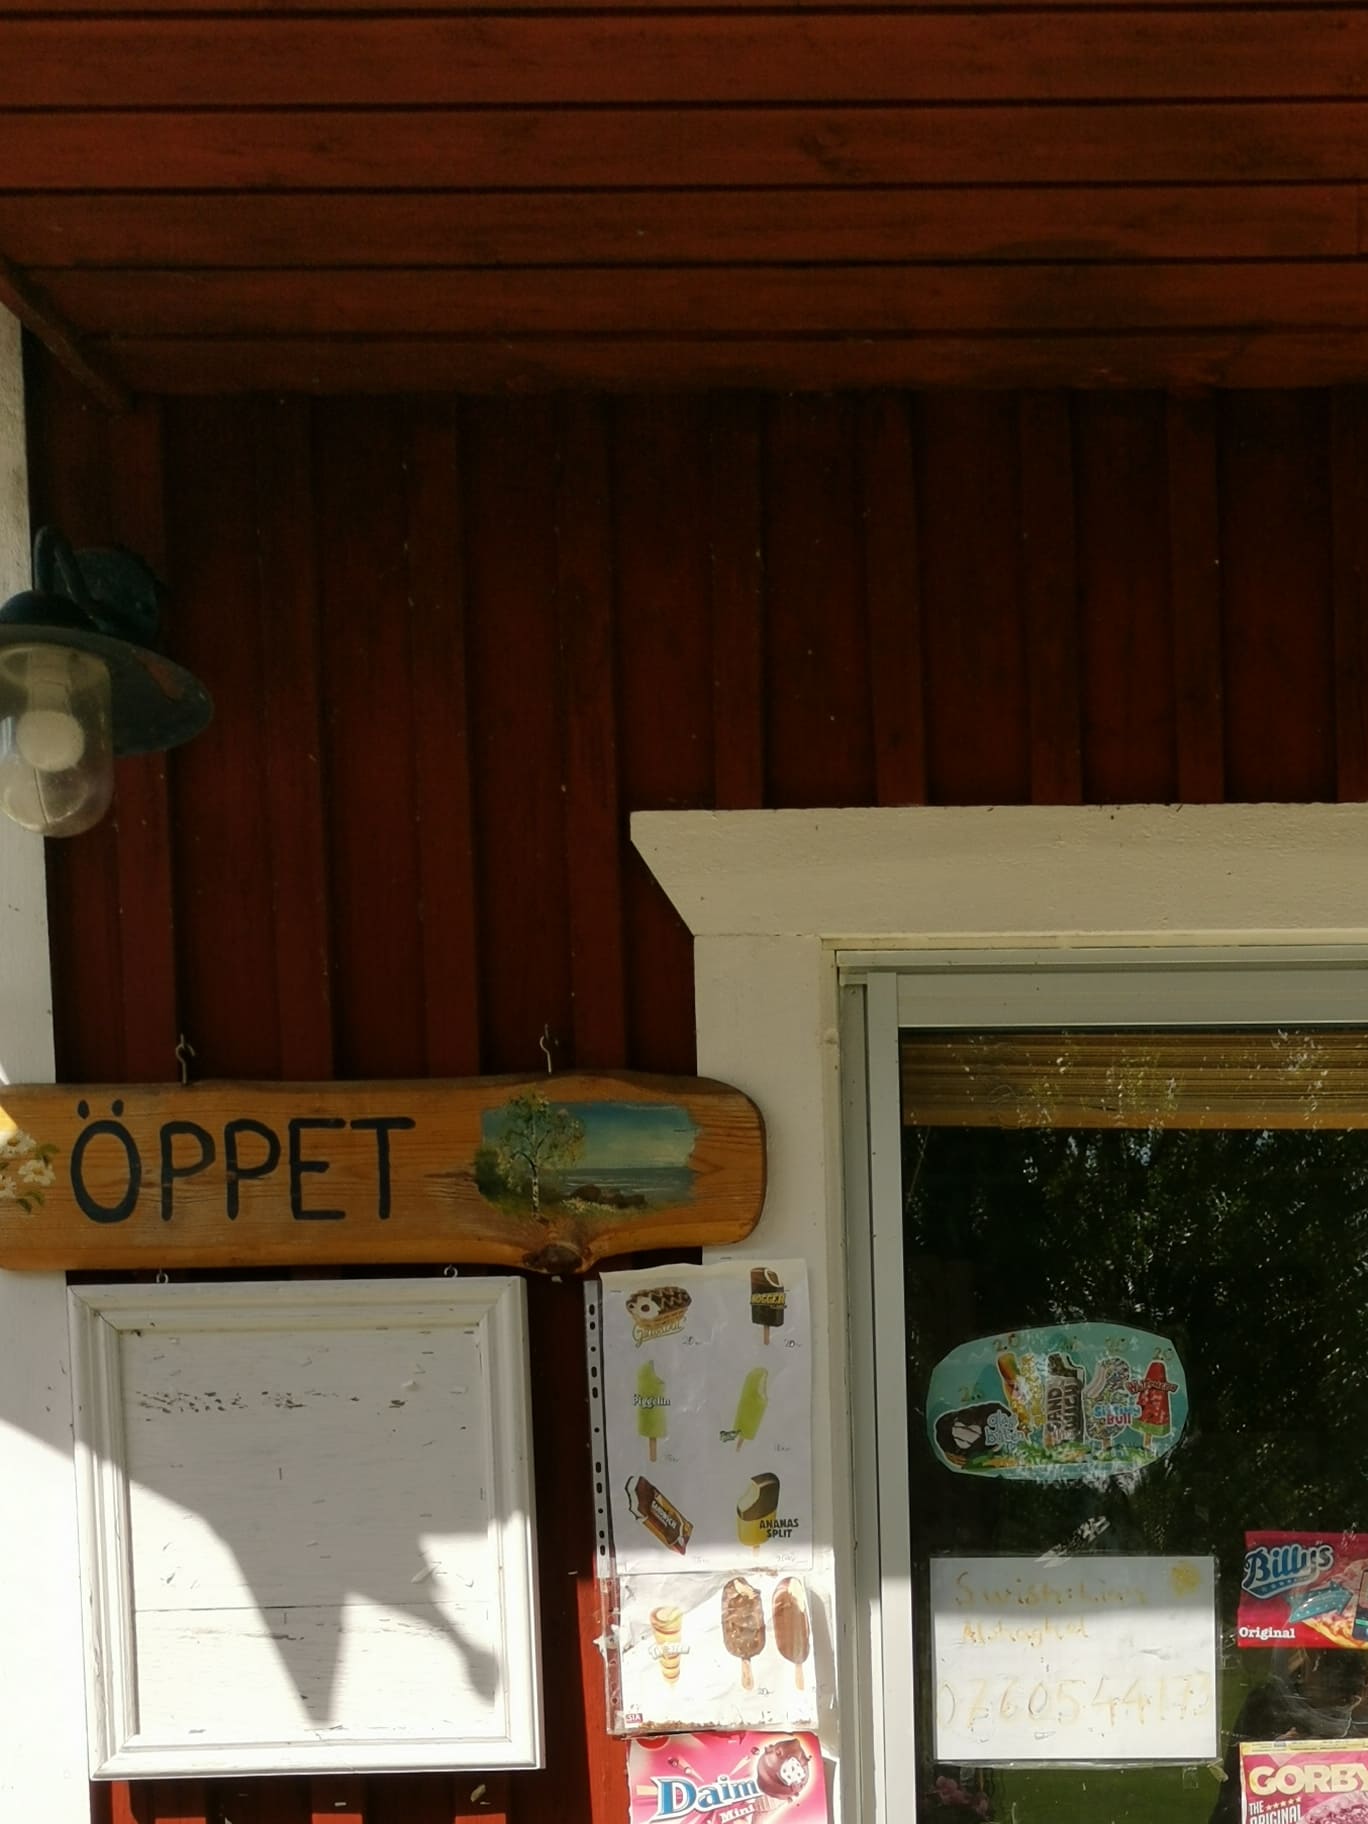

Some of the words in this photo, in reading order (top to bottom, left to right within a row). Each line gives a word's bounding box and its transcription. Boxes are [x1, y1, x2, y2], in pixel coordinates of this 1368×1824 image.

[69, 1098, 416, 1223] ÖPPET
[759, 1518, 800, 1529] ANANAS
[766, 1529, 792, 1539] SPLIT
[1239, 1627, 1296, 1642] Original
[652, 1776, 759, 1822] Daim
[720, 1804, 755, 1824] Mini
[1249, 1800, 1264, 1815] THE
